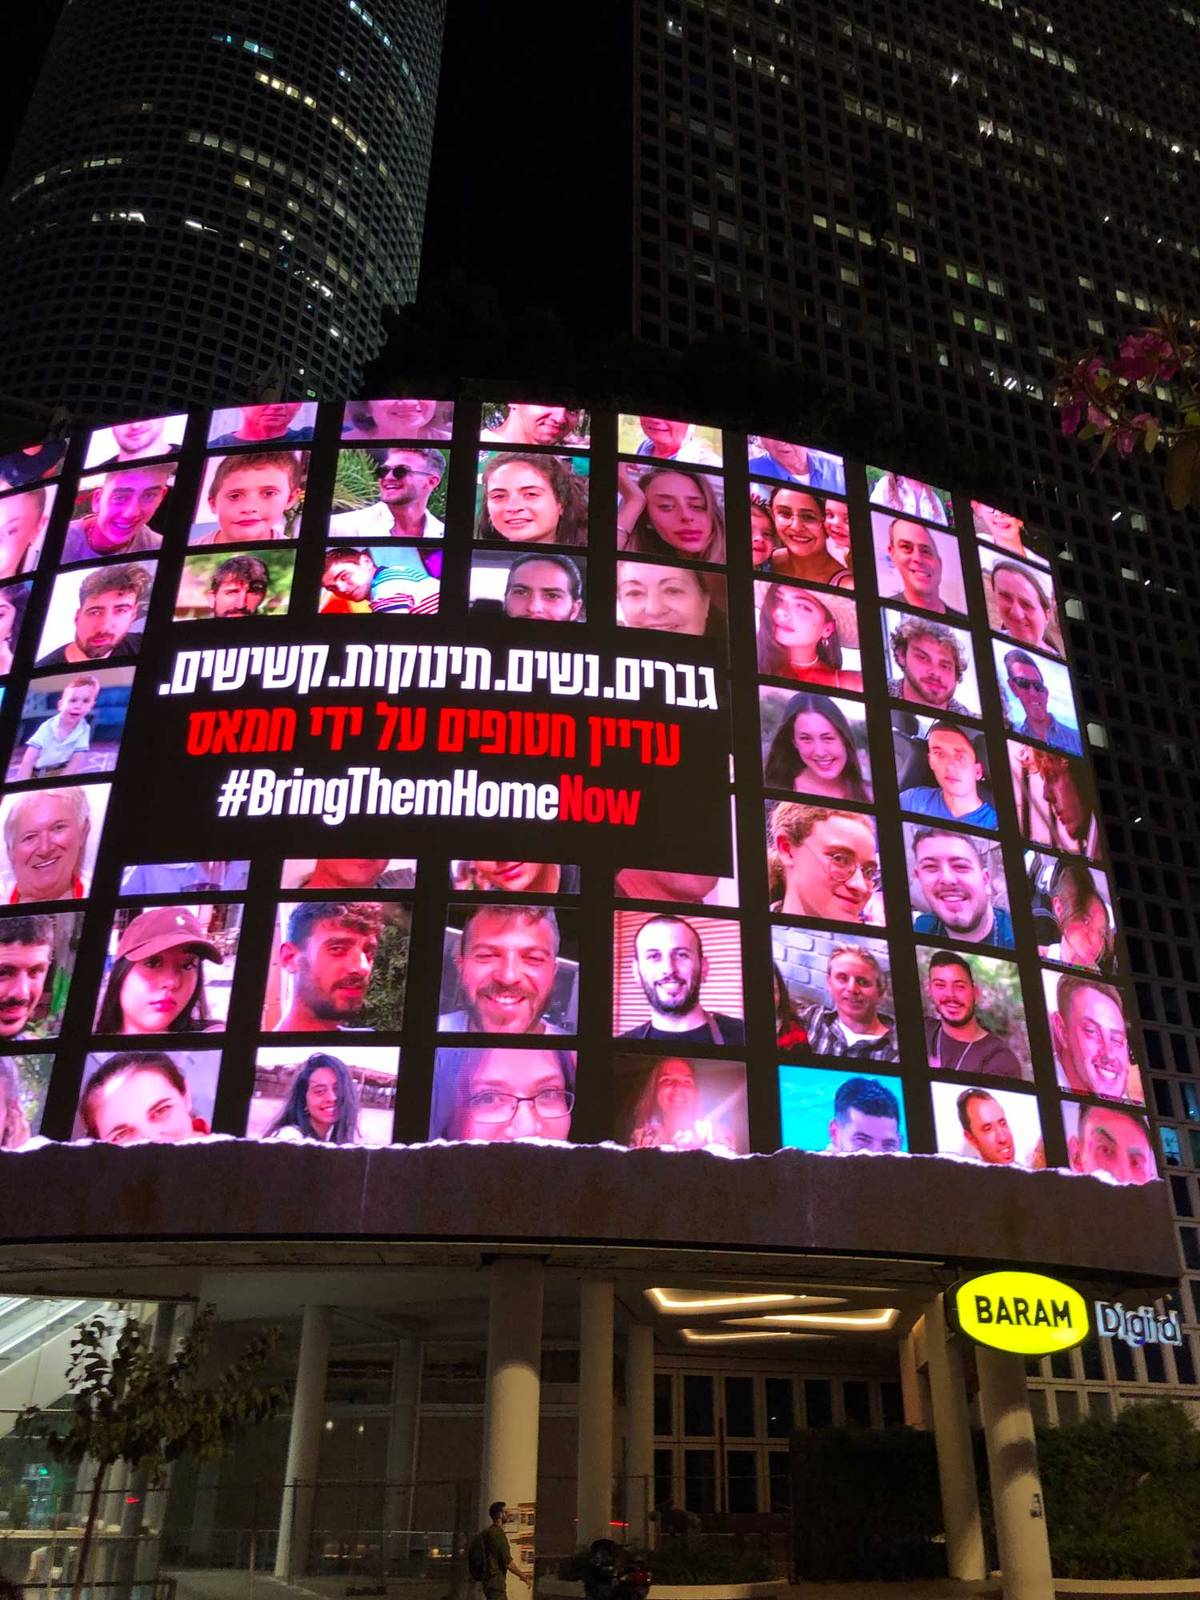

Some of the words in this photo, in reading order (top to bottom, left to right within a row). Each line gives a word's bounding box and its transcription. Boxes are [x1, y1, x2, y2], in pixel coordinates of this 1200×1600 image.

[186, 707, 298, 756] חמאס
[309, 706, 364, 751] ידי
[375, 701, 427, 751] על
[437, 707, 577, 759] חטופים
[588, 715, 681, 768] עדיין
[217, 767, 641, 826] #BringThemHomeNow
[974, 1295, 1073, 1329] BARAM
